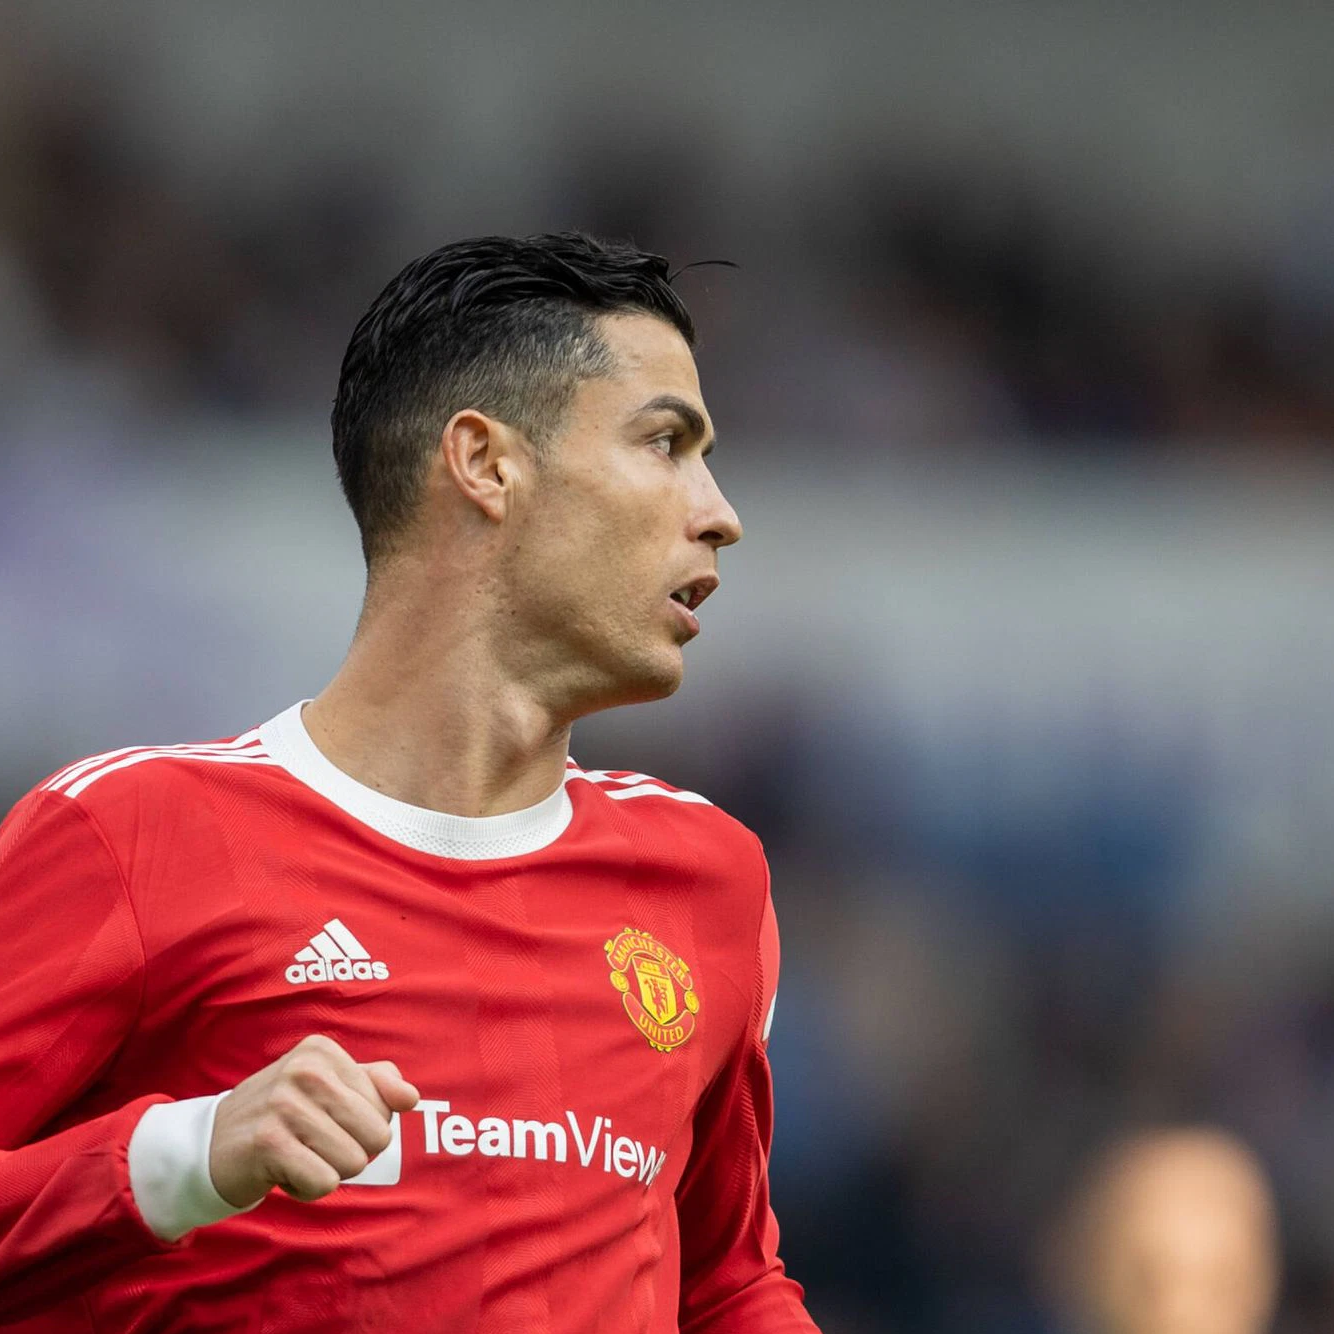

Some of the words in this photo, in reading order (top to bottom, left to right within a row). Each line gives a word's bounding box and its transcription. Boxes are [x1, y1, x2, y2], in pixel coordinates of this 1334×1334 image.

[285, 958, 389, 984] adidas
[613, 936, 686, 982] MANCHESTER
[639, 1013, 684, 1042] UNITED
[413, 1099, 666, 1187] TeamView
